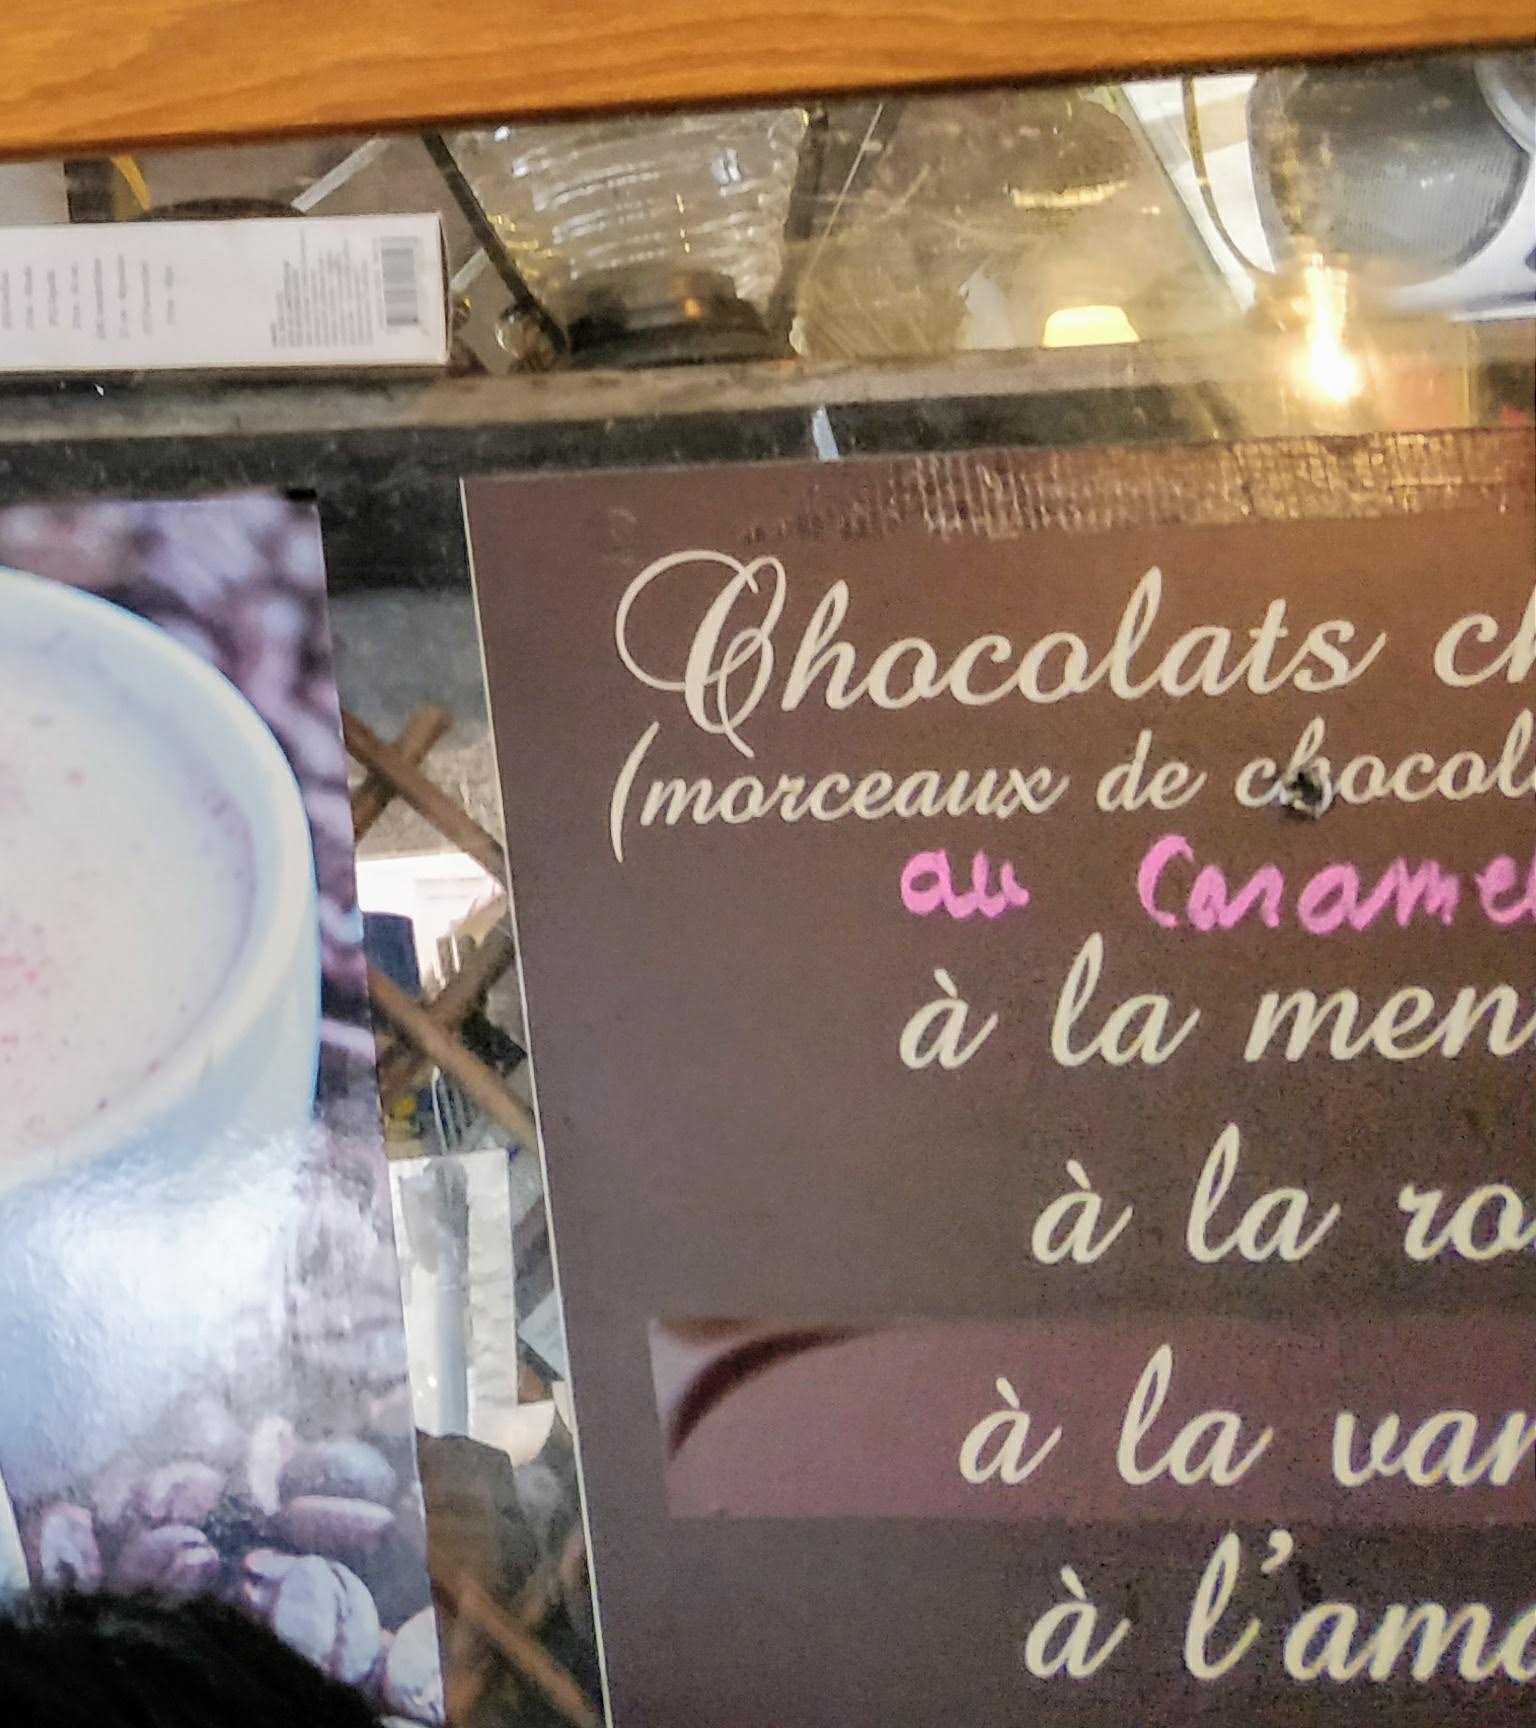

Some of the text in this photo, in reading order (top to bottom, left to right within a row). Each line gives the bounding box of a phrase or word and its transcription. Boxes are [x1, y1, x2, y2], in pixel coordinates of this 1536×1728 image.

[614, 549, 1387, 758] Chocolats
[609, 721, 1070, 863] (morceaux
[1096, 728, 1207, 813] de
[899, 832, 1536, 933] au Carame
[898, 966, 999, 1069] à
[1049, 932, 1200, 1069] la
[1030, 1160, 1134, 1264] à
[1185, 1122, 1340, 1264] la
[957, 1377, 1063, 1486] à
[1116, 1343, 1274, 1487] la
[1024, 1566, 1131, 1680] à
